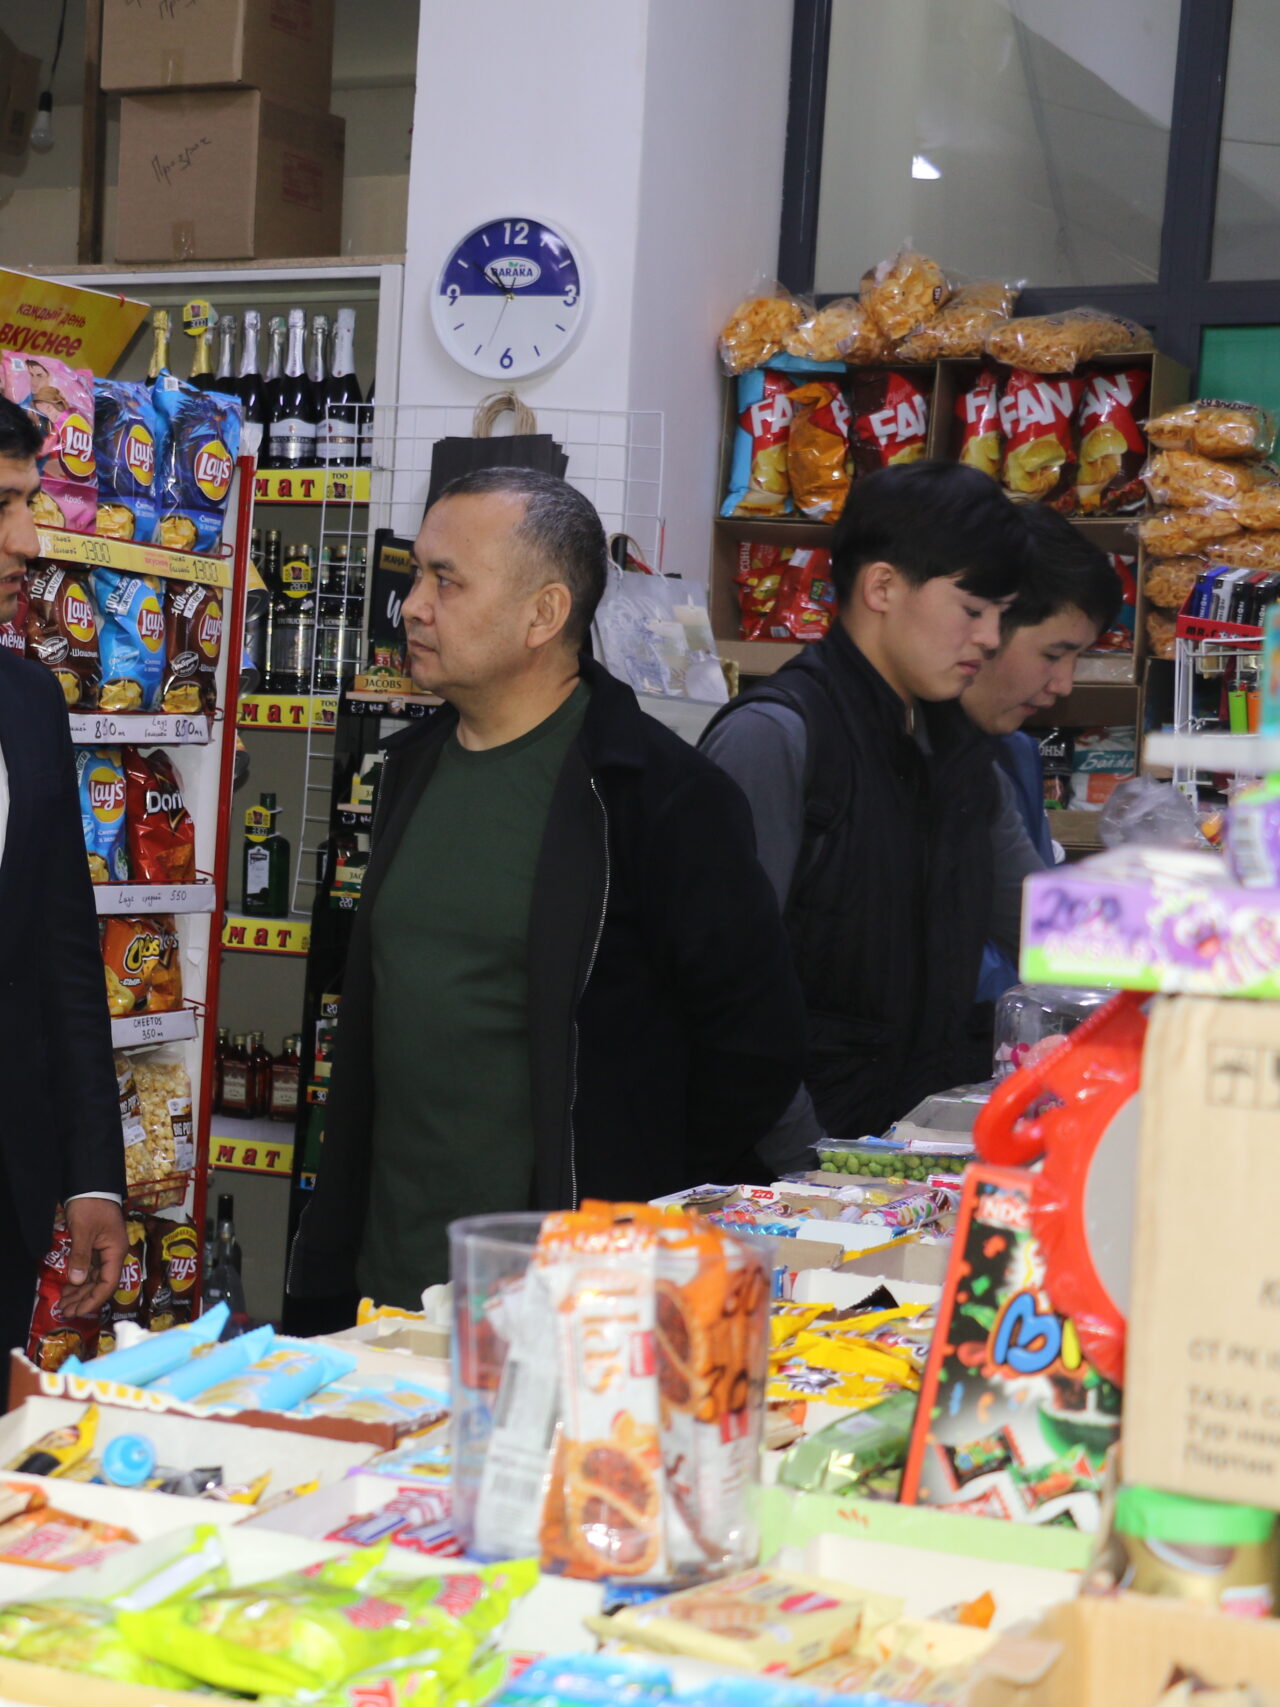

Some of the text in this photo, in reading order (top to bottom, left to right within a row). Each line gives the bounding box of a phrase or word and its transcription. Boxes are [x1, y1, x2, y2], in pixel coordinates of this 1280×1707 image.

[504, 222, 530, 245] 12
[447, 284, 577, 307] 9 3
[16, 302, 86, 328] каждый день
[500, 347, 513, 369] 6
[1000, 381, 1074, 438] FAN
[197, 452, 232, 487] Lay's
[68, 601, 93, 628] Lay's
[141, 608, 165, 640] Lay's
[364, 678, 402, 689] JACOBS
[90, 775, 125, 811] Lay's
[170, 889, 187, 901] 550
